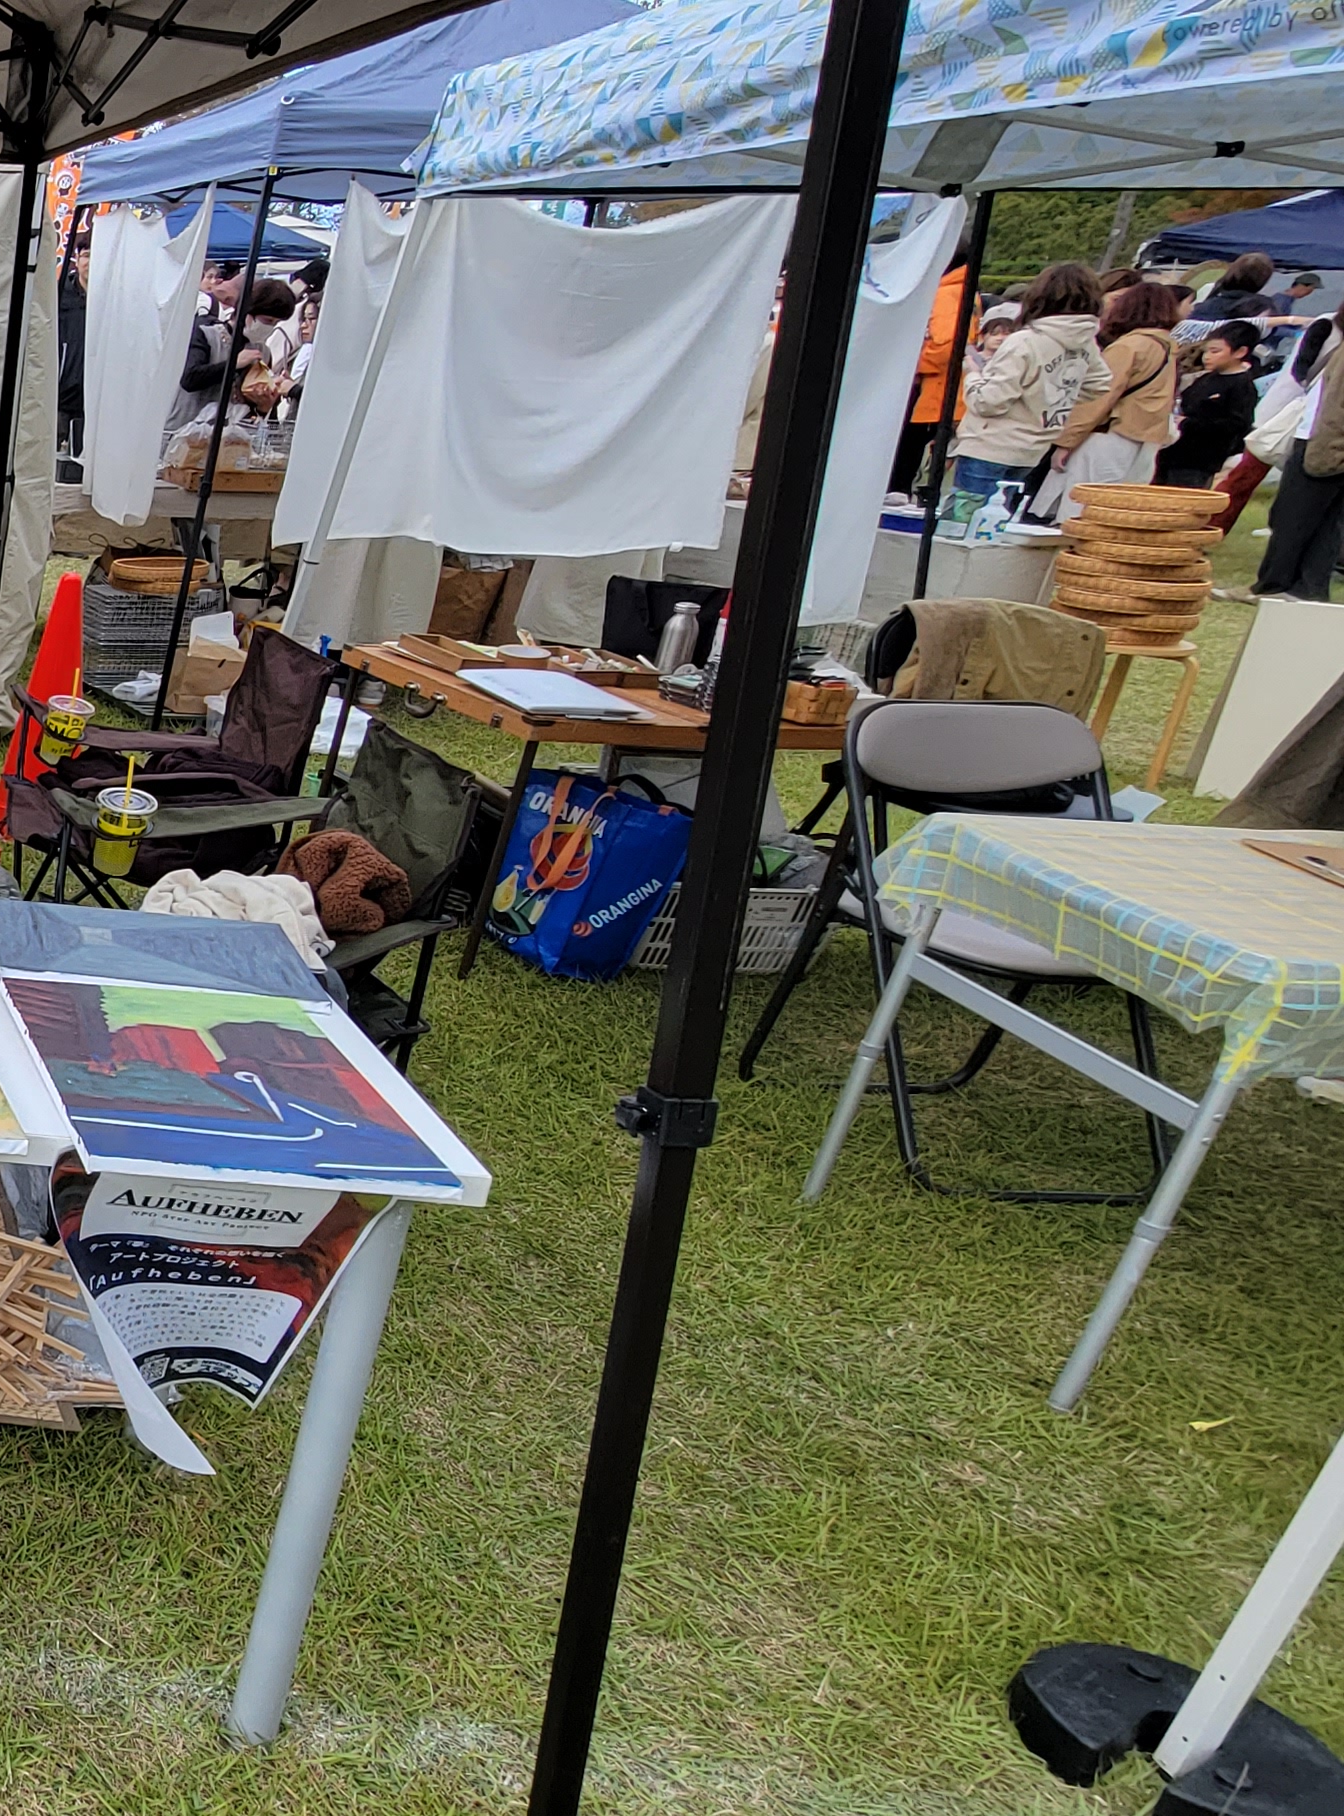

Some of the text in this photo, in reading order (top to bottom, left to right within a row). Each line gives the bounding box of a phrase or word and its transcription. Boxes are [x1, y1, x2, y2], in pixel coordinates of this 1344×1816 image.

[588, 878, 663, 929] ORANGINA
[106, 1188, 305, 1225] AUFHEBEN
[109, 1252, 240, 1269] アートプロジェクト
